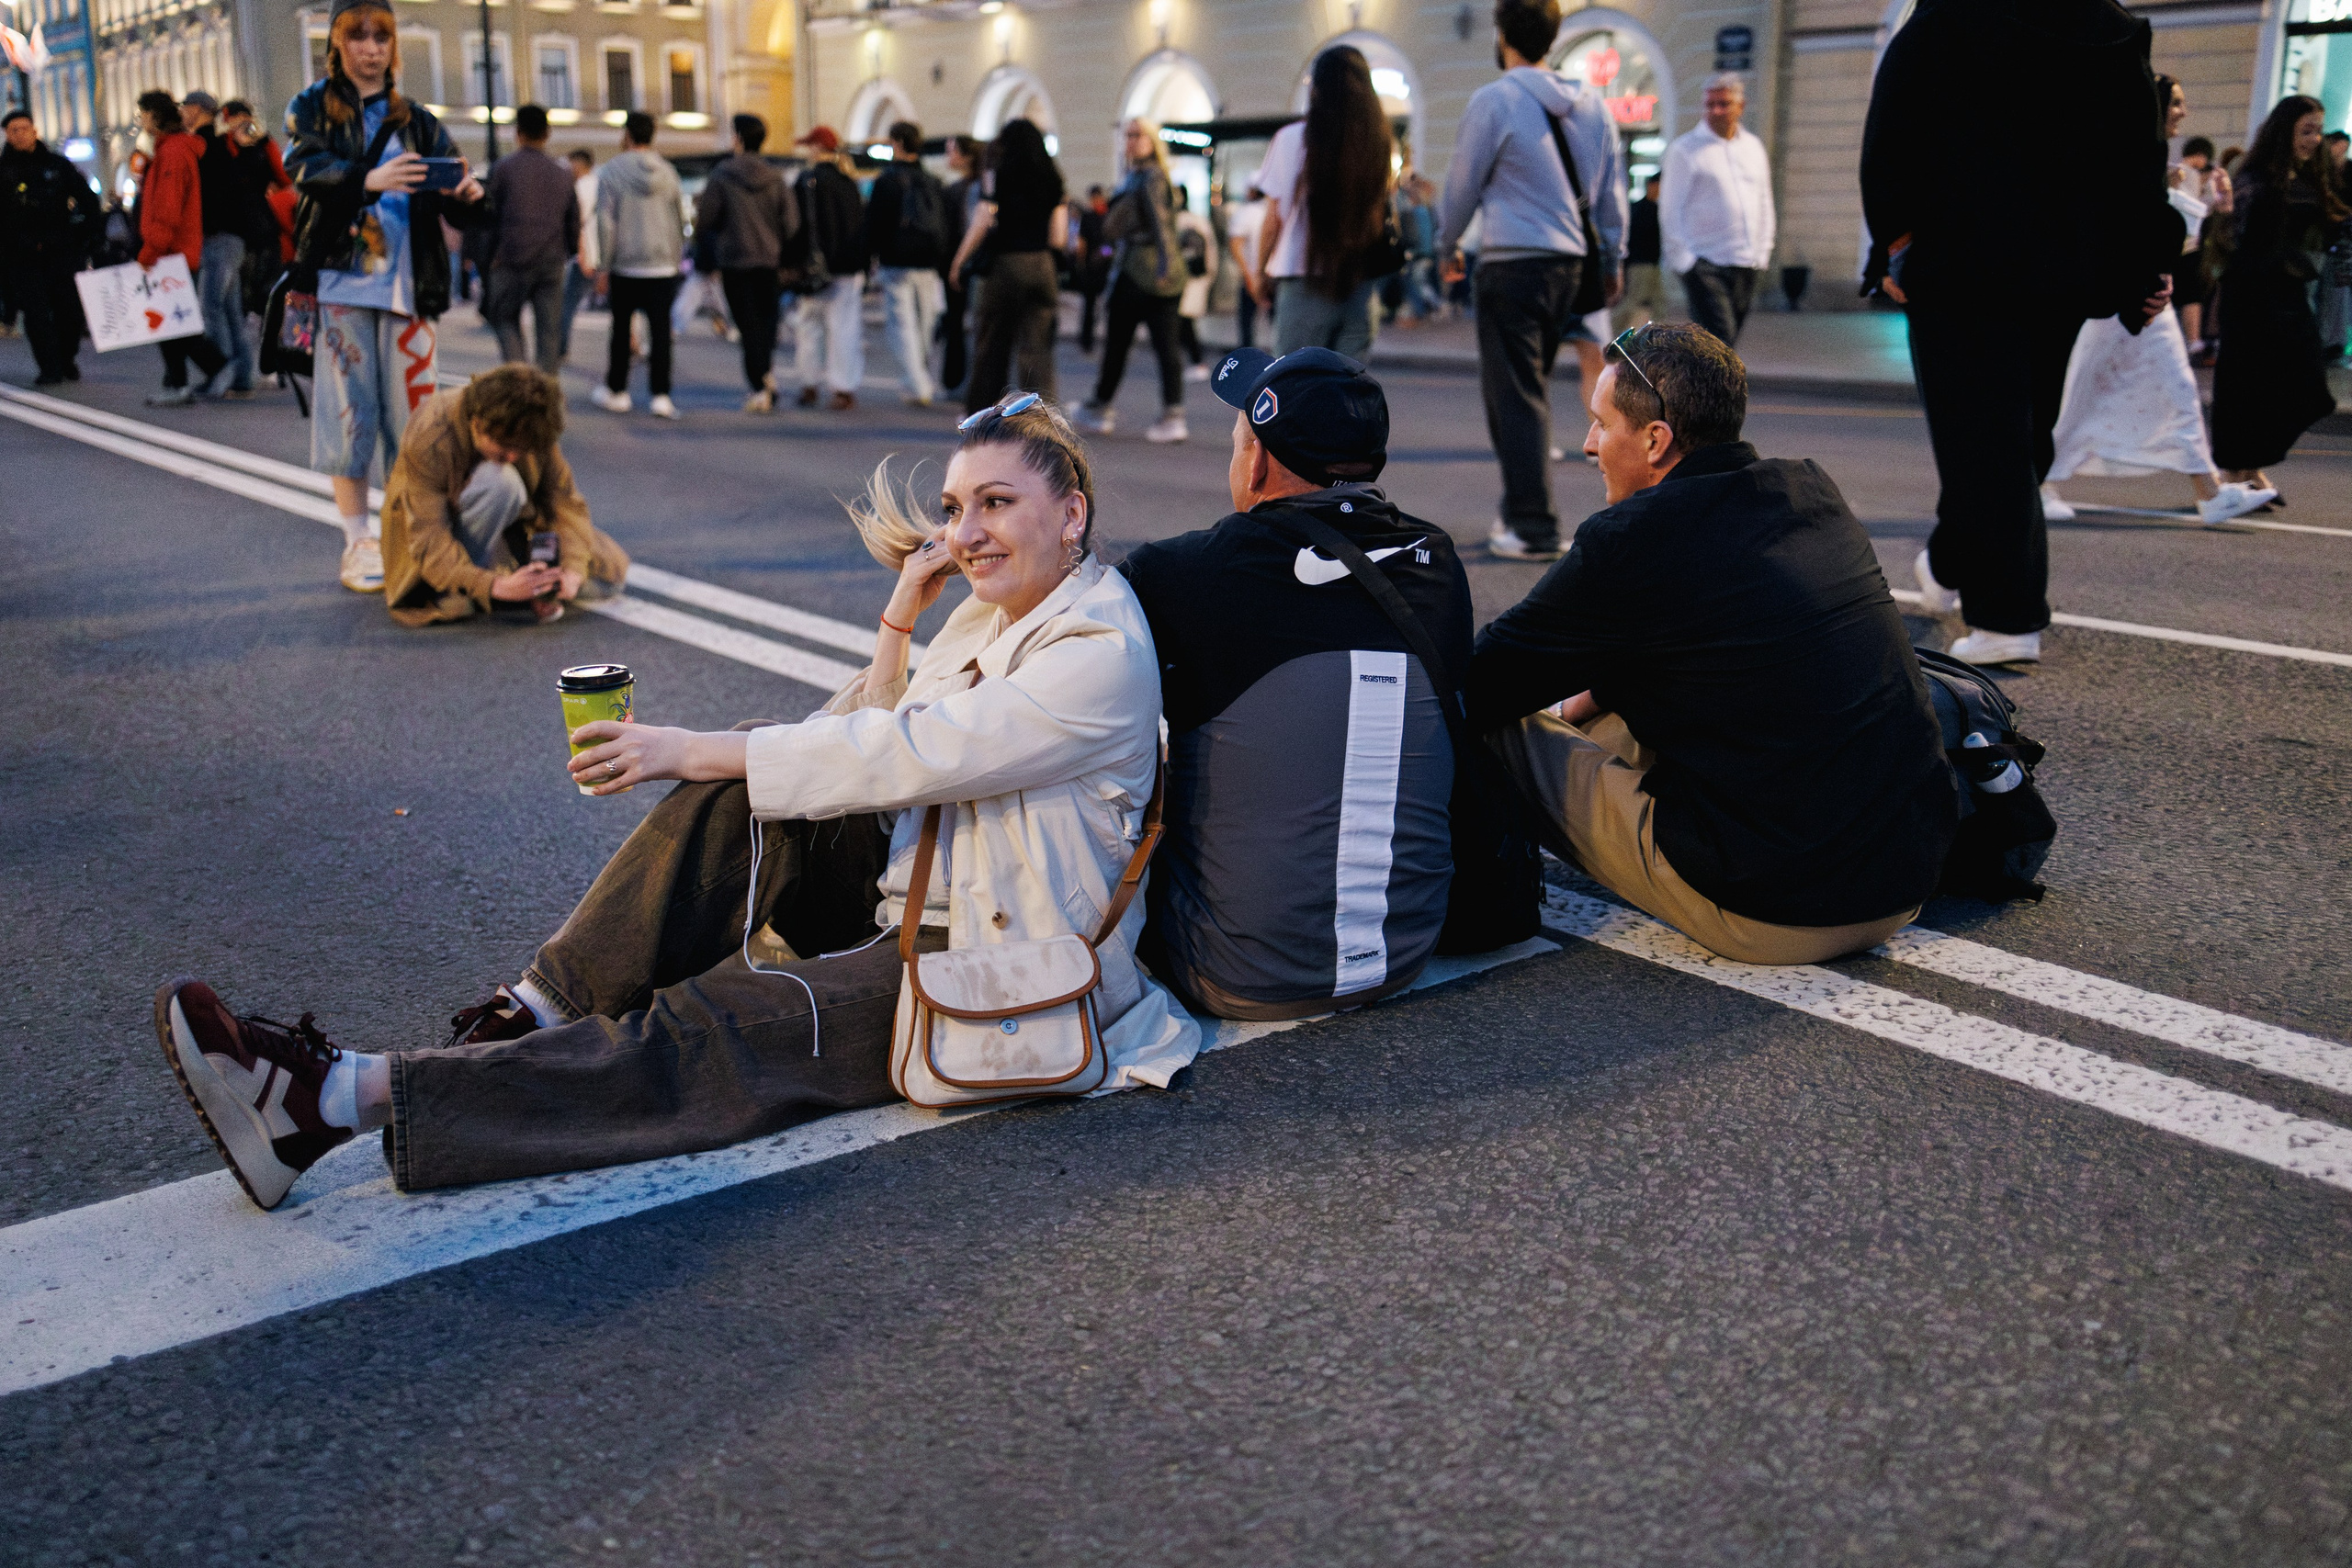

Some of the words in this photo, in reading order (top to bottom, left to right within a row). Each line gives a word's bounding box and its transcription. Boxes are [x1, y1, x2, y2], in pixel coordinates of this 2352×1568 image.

[1415, 547, 1430, 564] TM
[1360, 673, 1397, 684] REGISTERED
[1344, 949, 1380, 964] TRADEMARK
